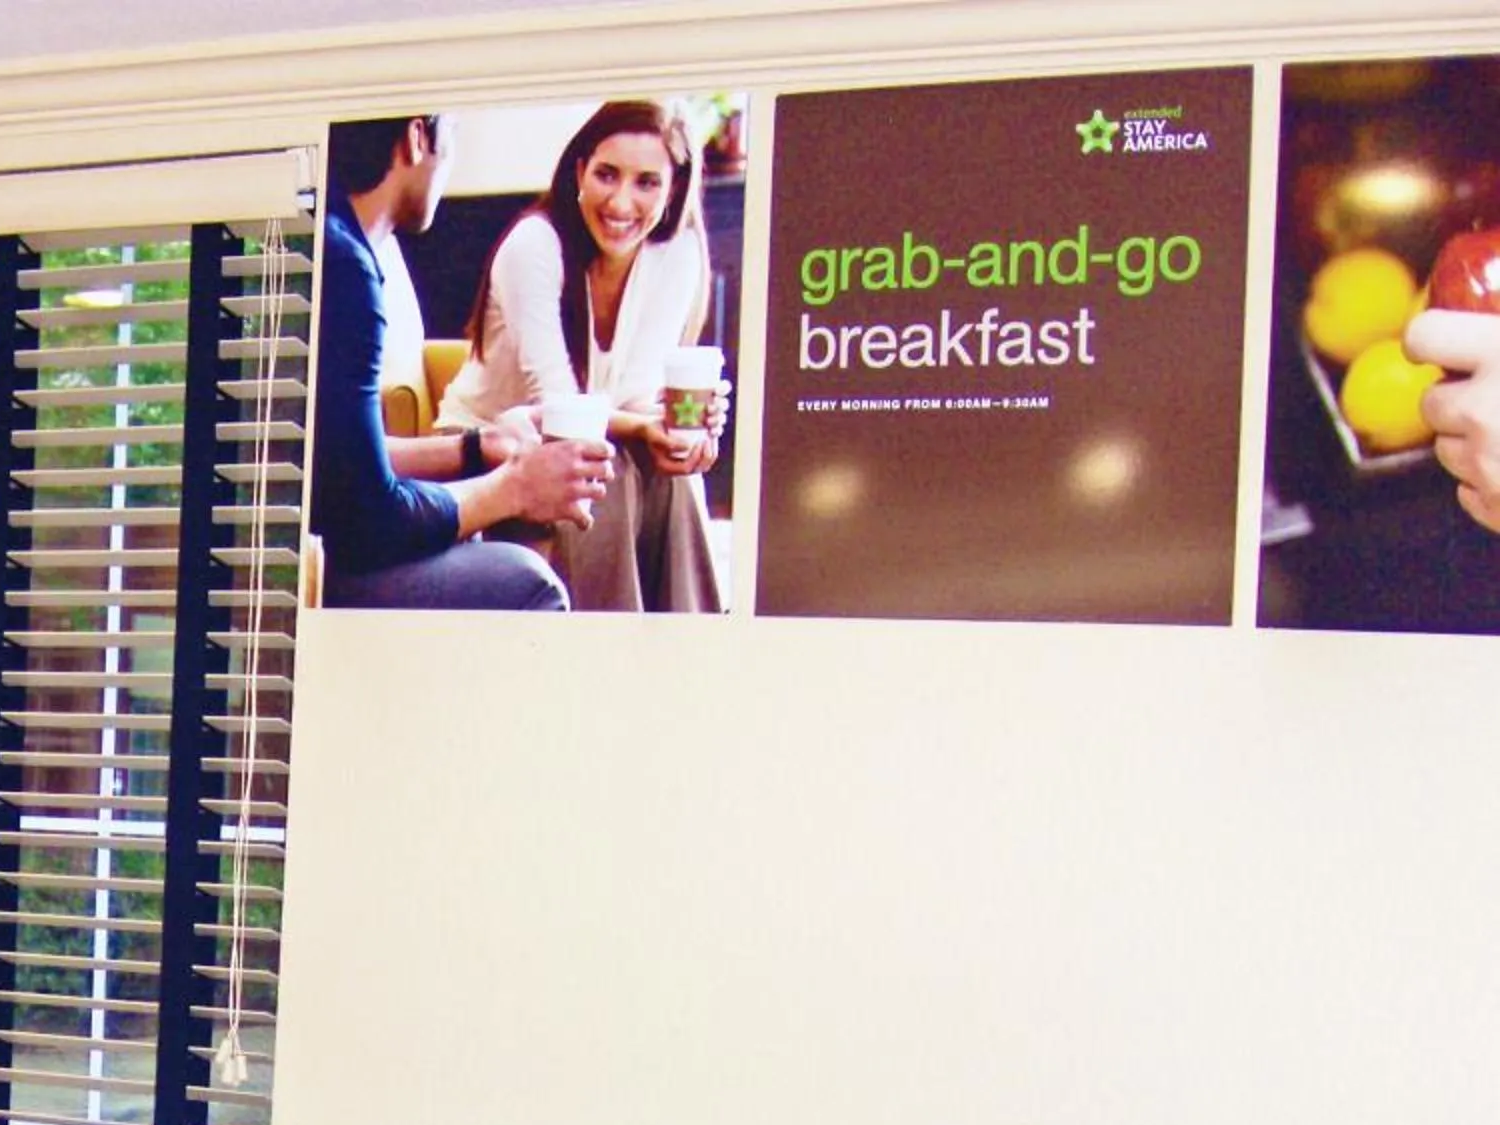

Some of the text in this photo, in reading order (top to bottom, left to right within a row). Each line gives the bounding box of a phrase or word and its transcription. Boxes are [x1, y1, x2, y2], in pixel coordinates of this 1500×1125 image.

[1123, 105, 1182, 119] extended
[1123, 119, 1167, 136] STAY
[1123, 132, 1208, 152] AMERICA
[800, 225, 1202, 306] grab-and-go
[799, 308, 1096, 370] breakfast
[797, 399, 837, 411] EVERY
[841, 398, 901, 411] MORNING
[904, 398, 941, 410] FROM
